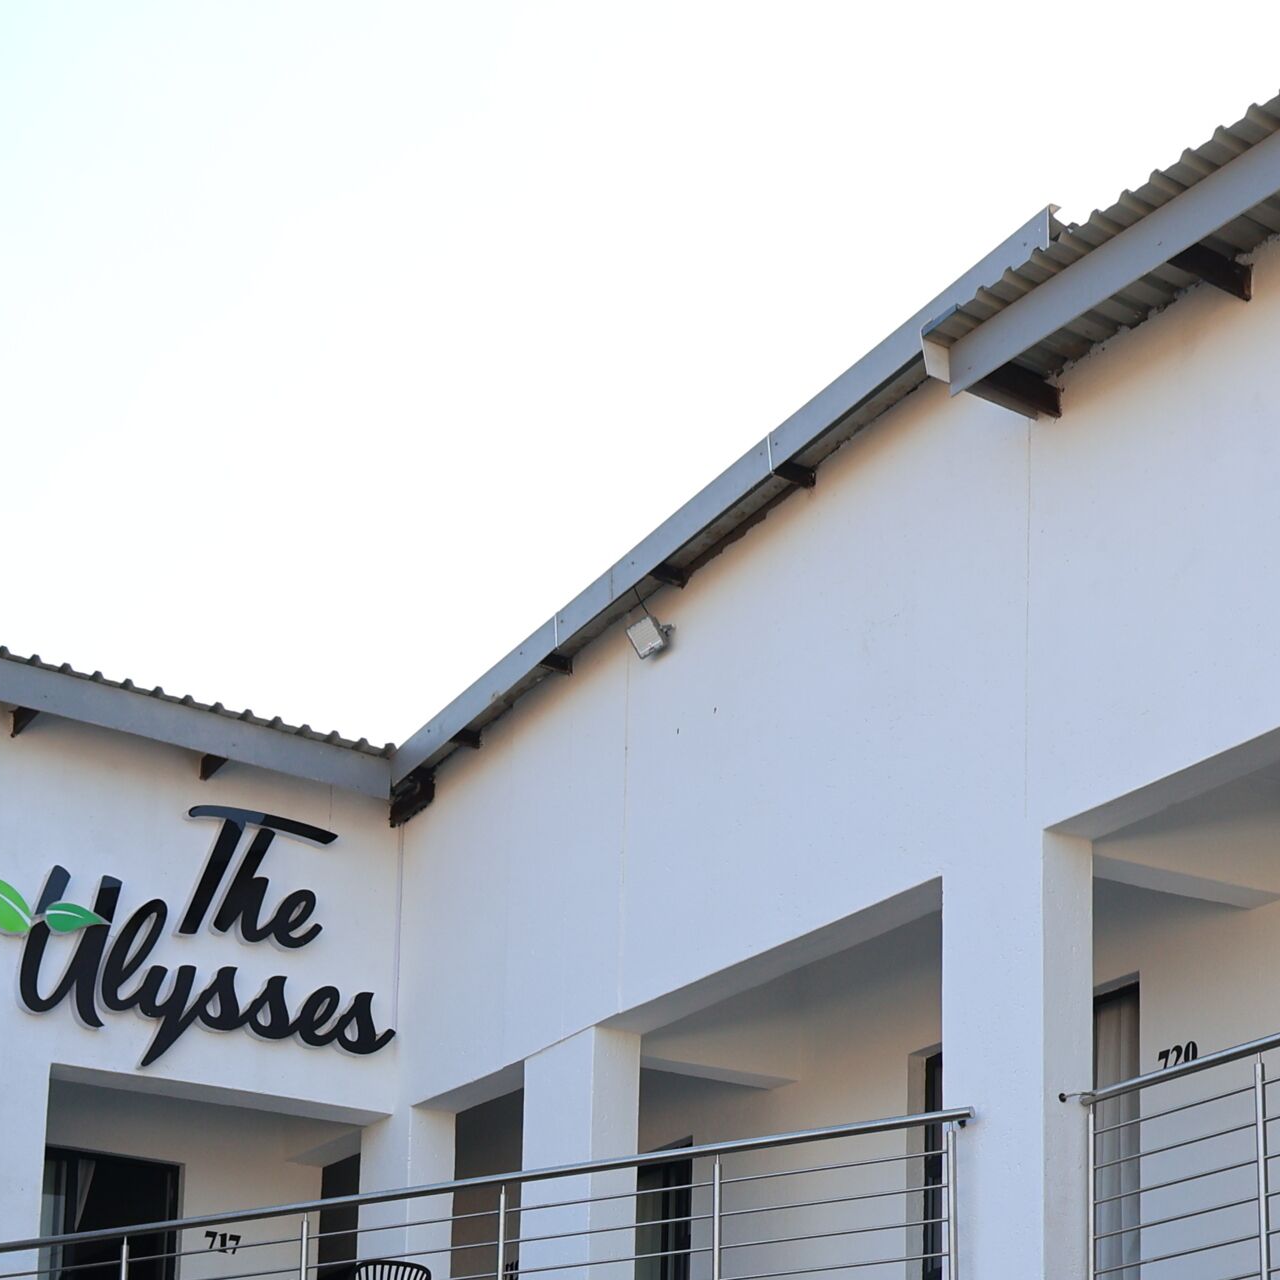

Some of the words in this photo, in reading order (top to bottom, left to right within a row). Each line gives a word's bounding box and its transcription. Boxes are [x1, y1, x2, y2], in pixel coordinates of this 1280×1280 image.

[177, 804, 338, 949] The
[18, 864, 397, 1067] Ulysses
[1158, 1040, 1198, 1070] 720
[204, 1230, 241, 1255] 717
